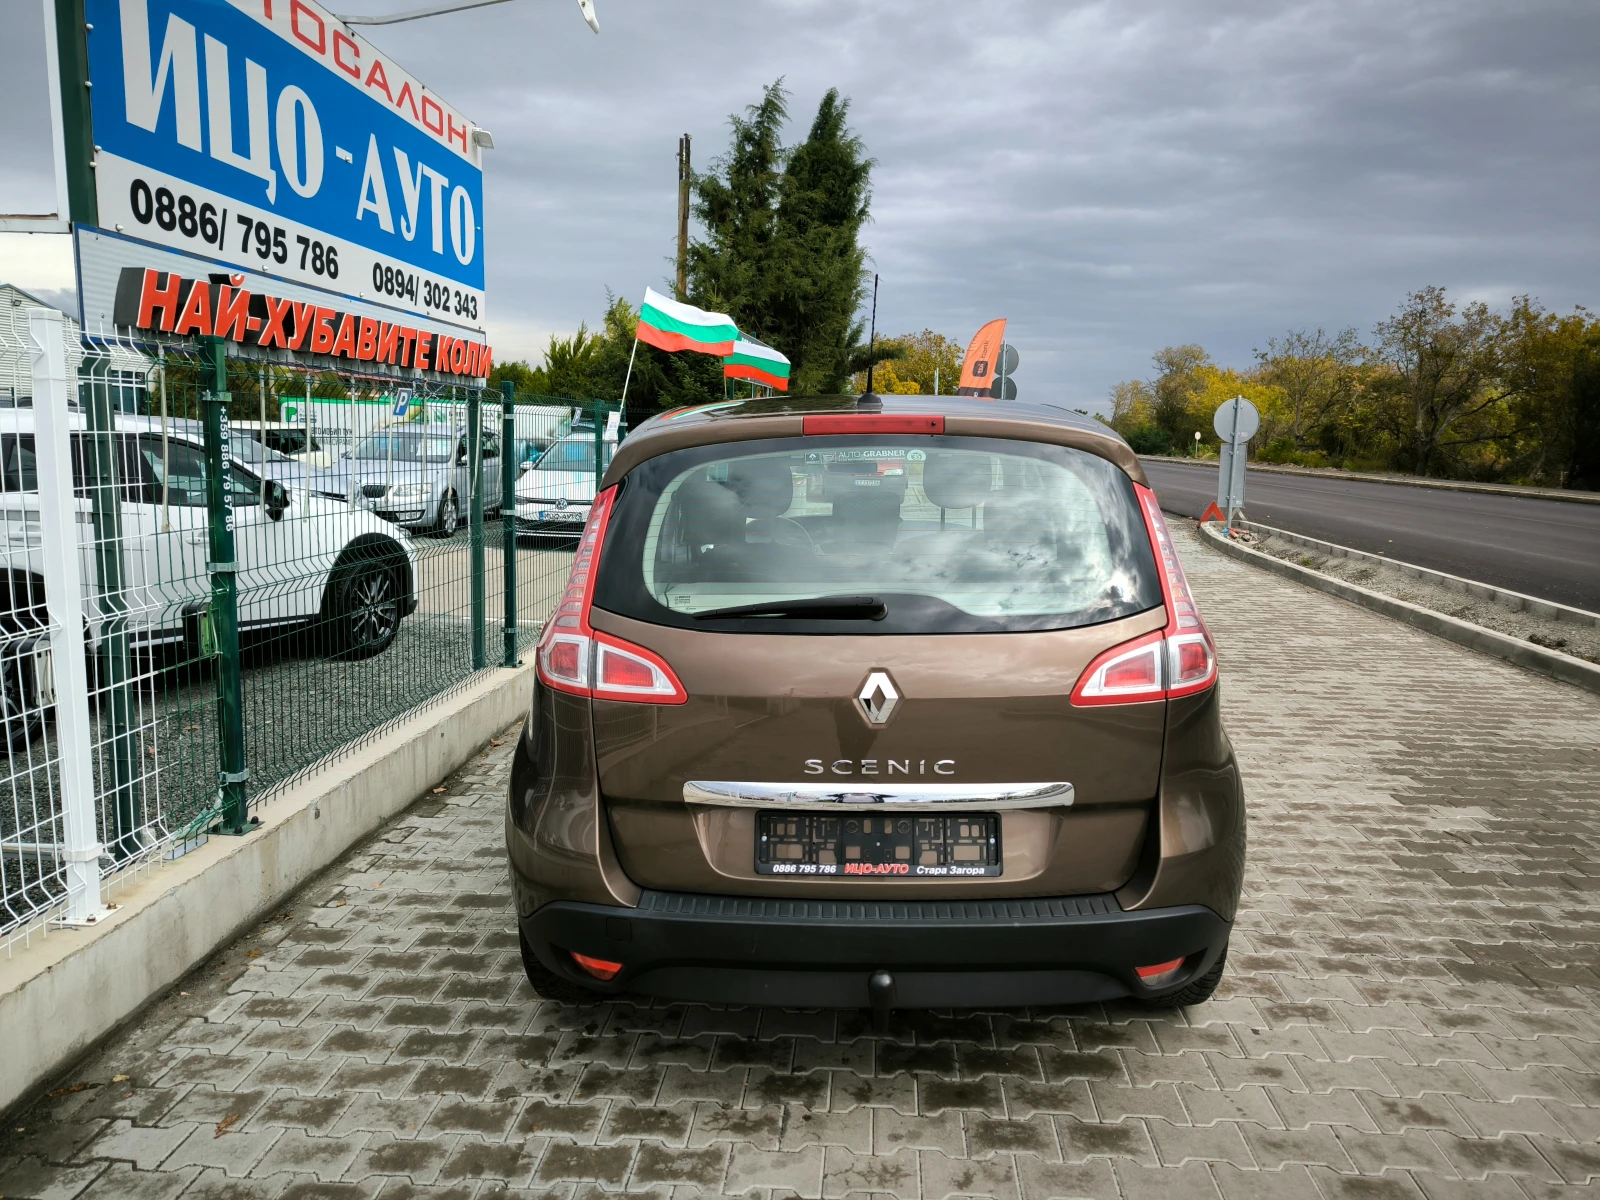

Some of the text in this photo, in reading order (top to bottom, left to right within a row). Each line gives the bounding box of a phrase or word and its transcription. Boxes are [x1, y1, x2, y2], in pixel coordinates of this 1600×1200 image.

[236, 214, 288, 265] 795
[296, 234, 339, 280] 786
[423, 279, 450, 313] 302
[454, 292, 478, 321] 343
[136, 267, 493, 379] НАЙ-ХУБАВИТЕ КОЛИ
[395, 393, 409, 413] P
[220, 406, 234, 532] +359 886 79 57 86
[804, 759, 955, 775] SCENIC
[773, 864, 837, 873] 0886 795 786
[844, 863, 909, 875] ИЦО-АУТО
[916, 865, 985, 875] Стара Загора
